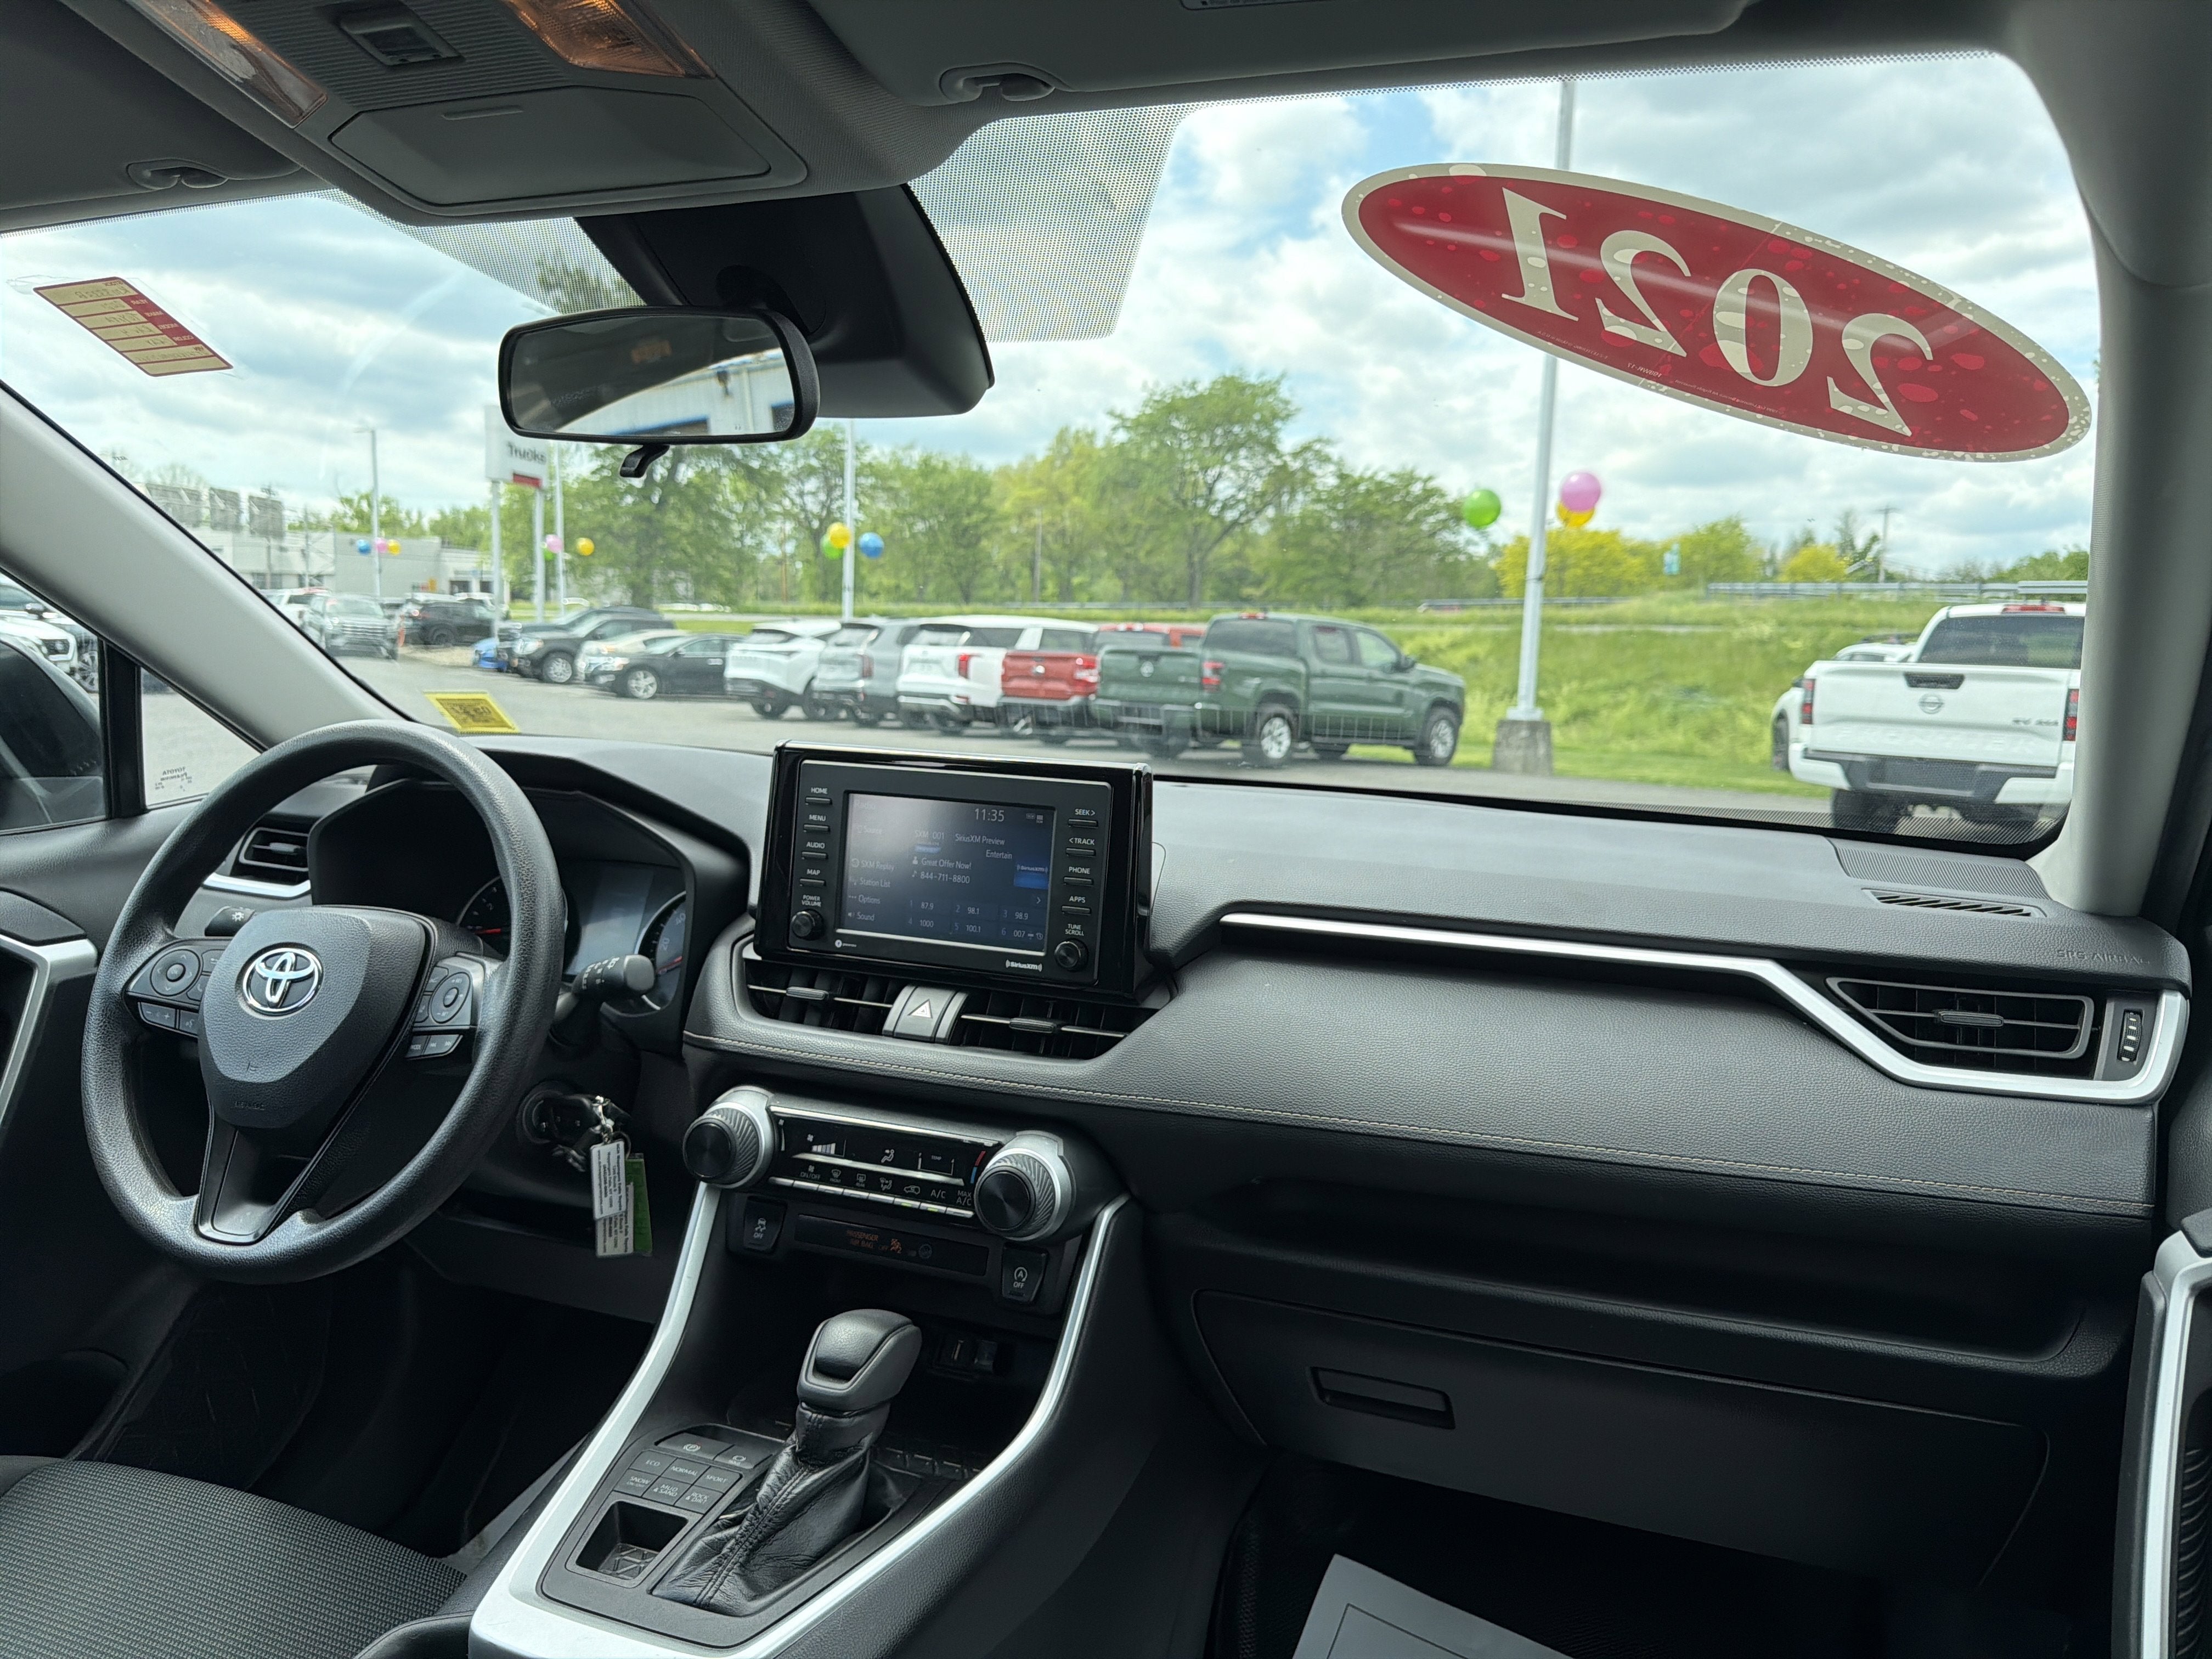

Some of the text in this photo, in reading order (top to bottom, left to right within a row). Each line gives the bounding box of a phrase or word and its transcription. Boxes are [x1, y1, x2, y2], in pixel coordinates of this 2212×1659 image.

[507, 441, 546, 465] Trucks
[974, 808, 1005, 822] 11:35
[915, 830, 944, 840] SXM 001
[955, 833, 1005, 845] SiriusXM Preview
[806, 841, 825, 849] AUDIO
[985, 849, 1013, 860] Entertain
[921, 857, 972, 870] Great Offer Now!
[1068, 866, 1091, 874] PHONE
[859, 877, 891, 888] Station List
[920, 871, 970, 884] 844-711-8800
[858, 894, 881, 905] Options
[1069, 895, 1086, 904] APPS
[921, 901, 934, 910] 87.9
[967, 907, 980, 915] 98.1
[1015, 912, 1029, 921] 98.9
[856, 911, 875, 922] Sound
[919, 919, 934, 928] 1000
[966, 924, 981, 933] 100.1
[1013, 930, 1025, 938] 007
[930, 1189, 946, 1199] A/C
[957, 1189, 972, 1198] MAX
[956, 1196, 972, 1206] A/C
[670, 1465, 698, 1476] NORMAL
[630, 1476, 651, 1485] SNOW
[706, 1474, 729, 1483] SPORT
[658, 1488, 678, 1497] SAND
[660, 1483, 679, 1492] MUD
[691, 1492, 710, 1500] ROCK
[691, 1497, 708, 1505] DIRT
